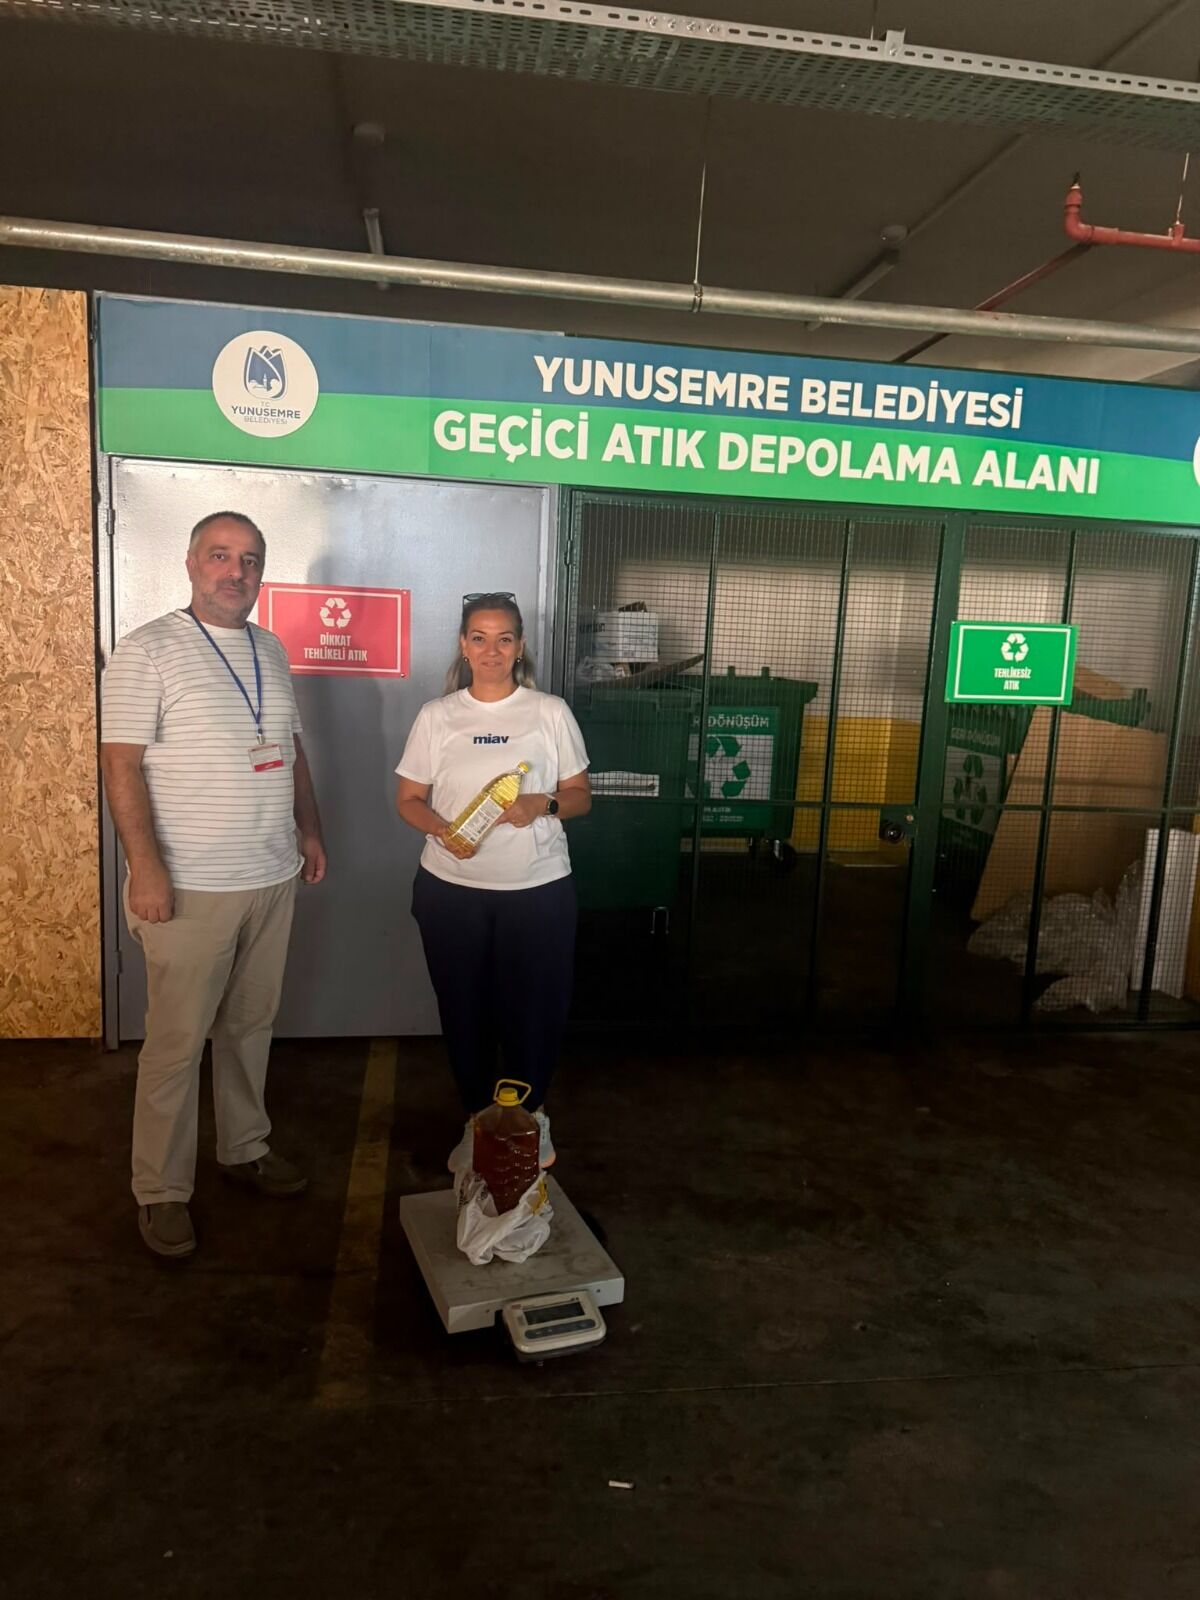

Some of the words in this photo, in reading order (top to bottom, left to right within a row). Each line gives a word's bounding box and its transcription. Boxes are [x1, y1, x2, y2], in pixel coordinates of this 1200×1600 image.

[534, 355, 790, 412] YUNUSEMRE
[801, 378, 1023, 429] BELEDİYESİ
[231, 405, 301, 419] YUNUSEMRE
[433, 407, 589, 464] GEÇİCİ
[602, 422, 706, 469] ATIK
[717, 431, 962, 485] DEPOLAMA
[971, 450, 1100, 495] ALANI
[320, 632, 351, 646] DİKKAT
[303, 646, 346, 660] TEHLİKELİ
[348, 650, 368, 661] ATIK
[994, 666, 1032, 679] TEHLİKESİZ
[1003, 680, 1020, 690] ATIK
[708, 713, 769, 729] DÖNÜŞÜM
[473, 733, 509, 744] miav
